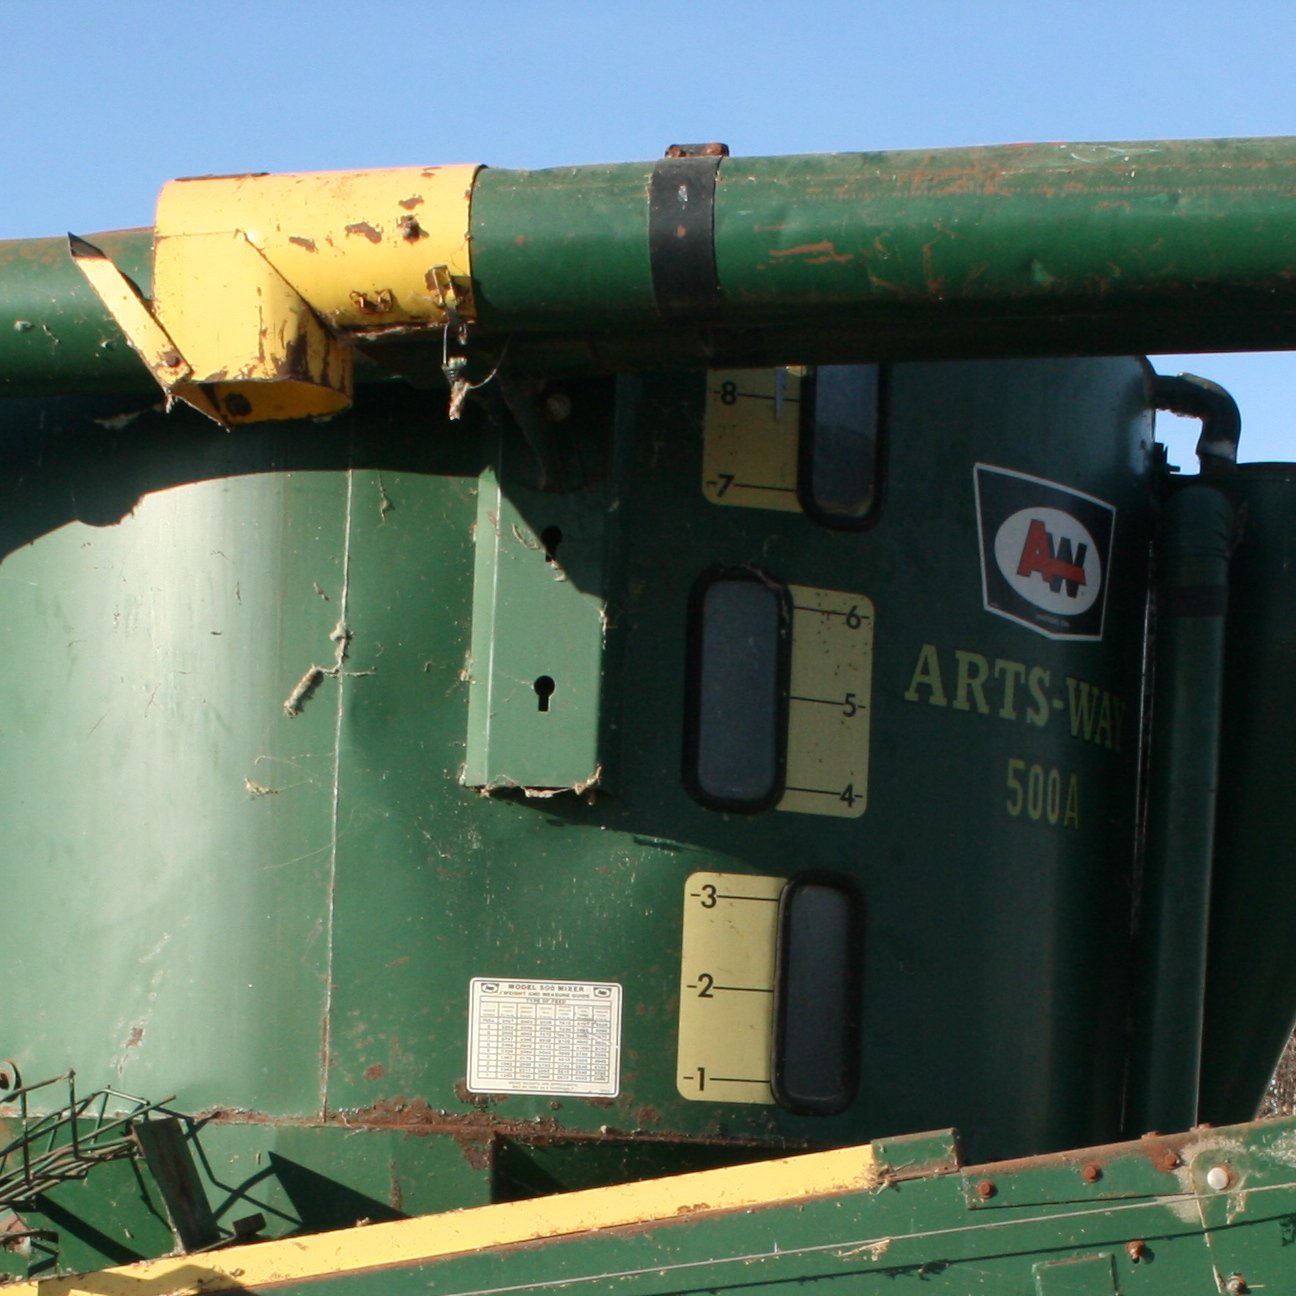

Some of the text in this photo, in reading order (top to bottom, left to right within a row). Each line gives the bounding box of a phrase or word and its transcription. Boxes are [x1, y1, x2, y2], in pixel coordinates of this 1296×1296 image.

[720, 381, 737, 405] 8
[716, 474, 735, 498] 7
[845, 606, 862, 630] 6
[841, 694, 857, 718] 5
[905, 643, 1126, 753] ARTS-WAY
[839, 784, 855, 808] 4
[1006, 758, 1081, 830] 500A
[701, 884, 718, 909] 3
[508, 983, 537, 991] MODEL
[557, 985, 584, 993] MIXER
[697, 973, 714, 998] 2
[695, 1066, 706, 1091] 1
